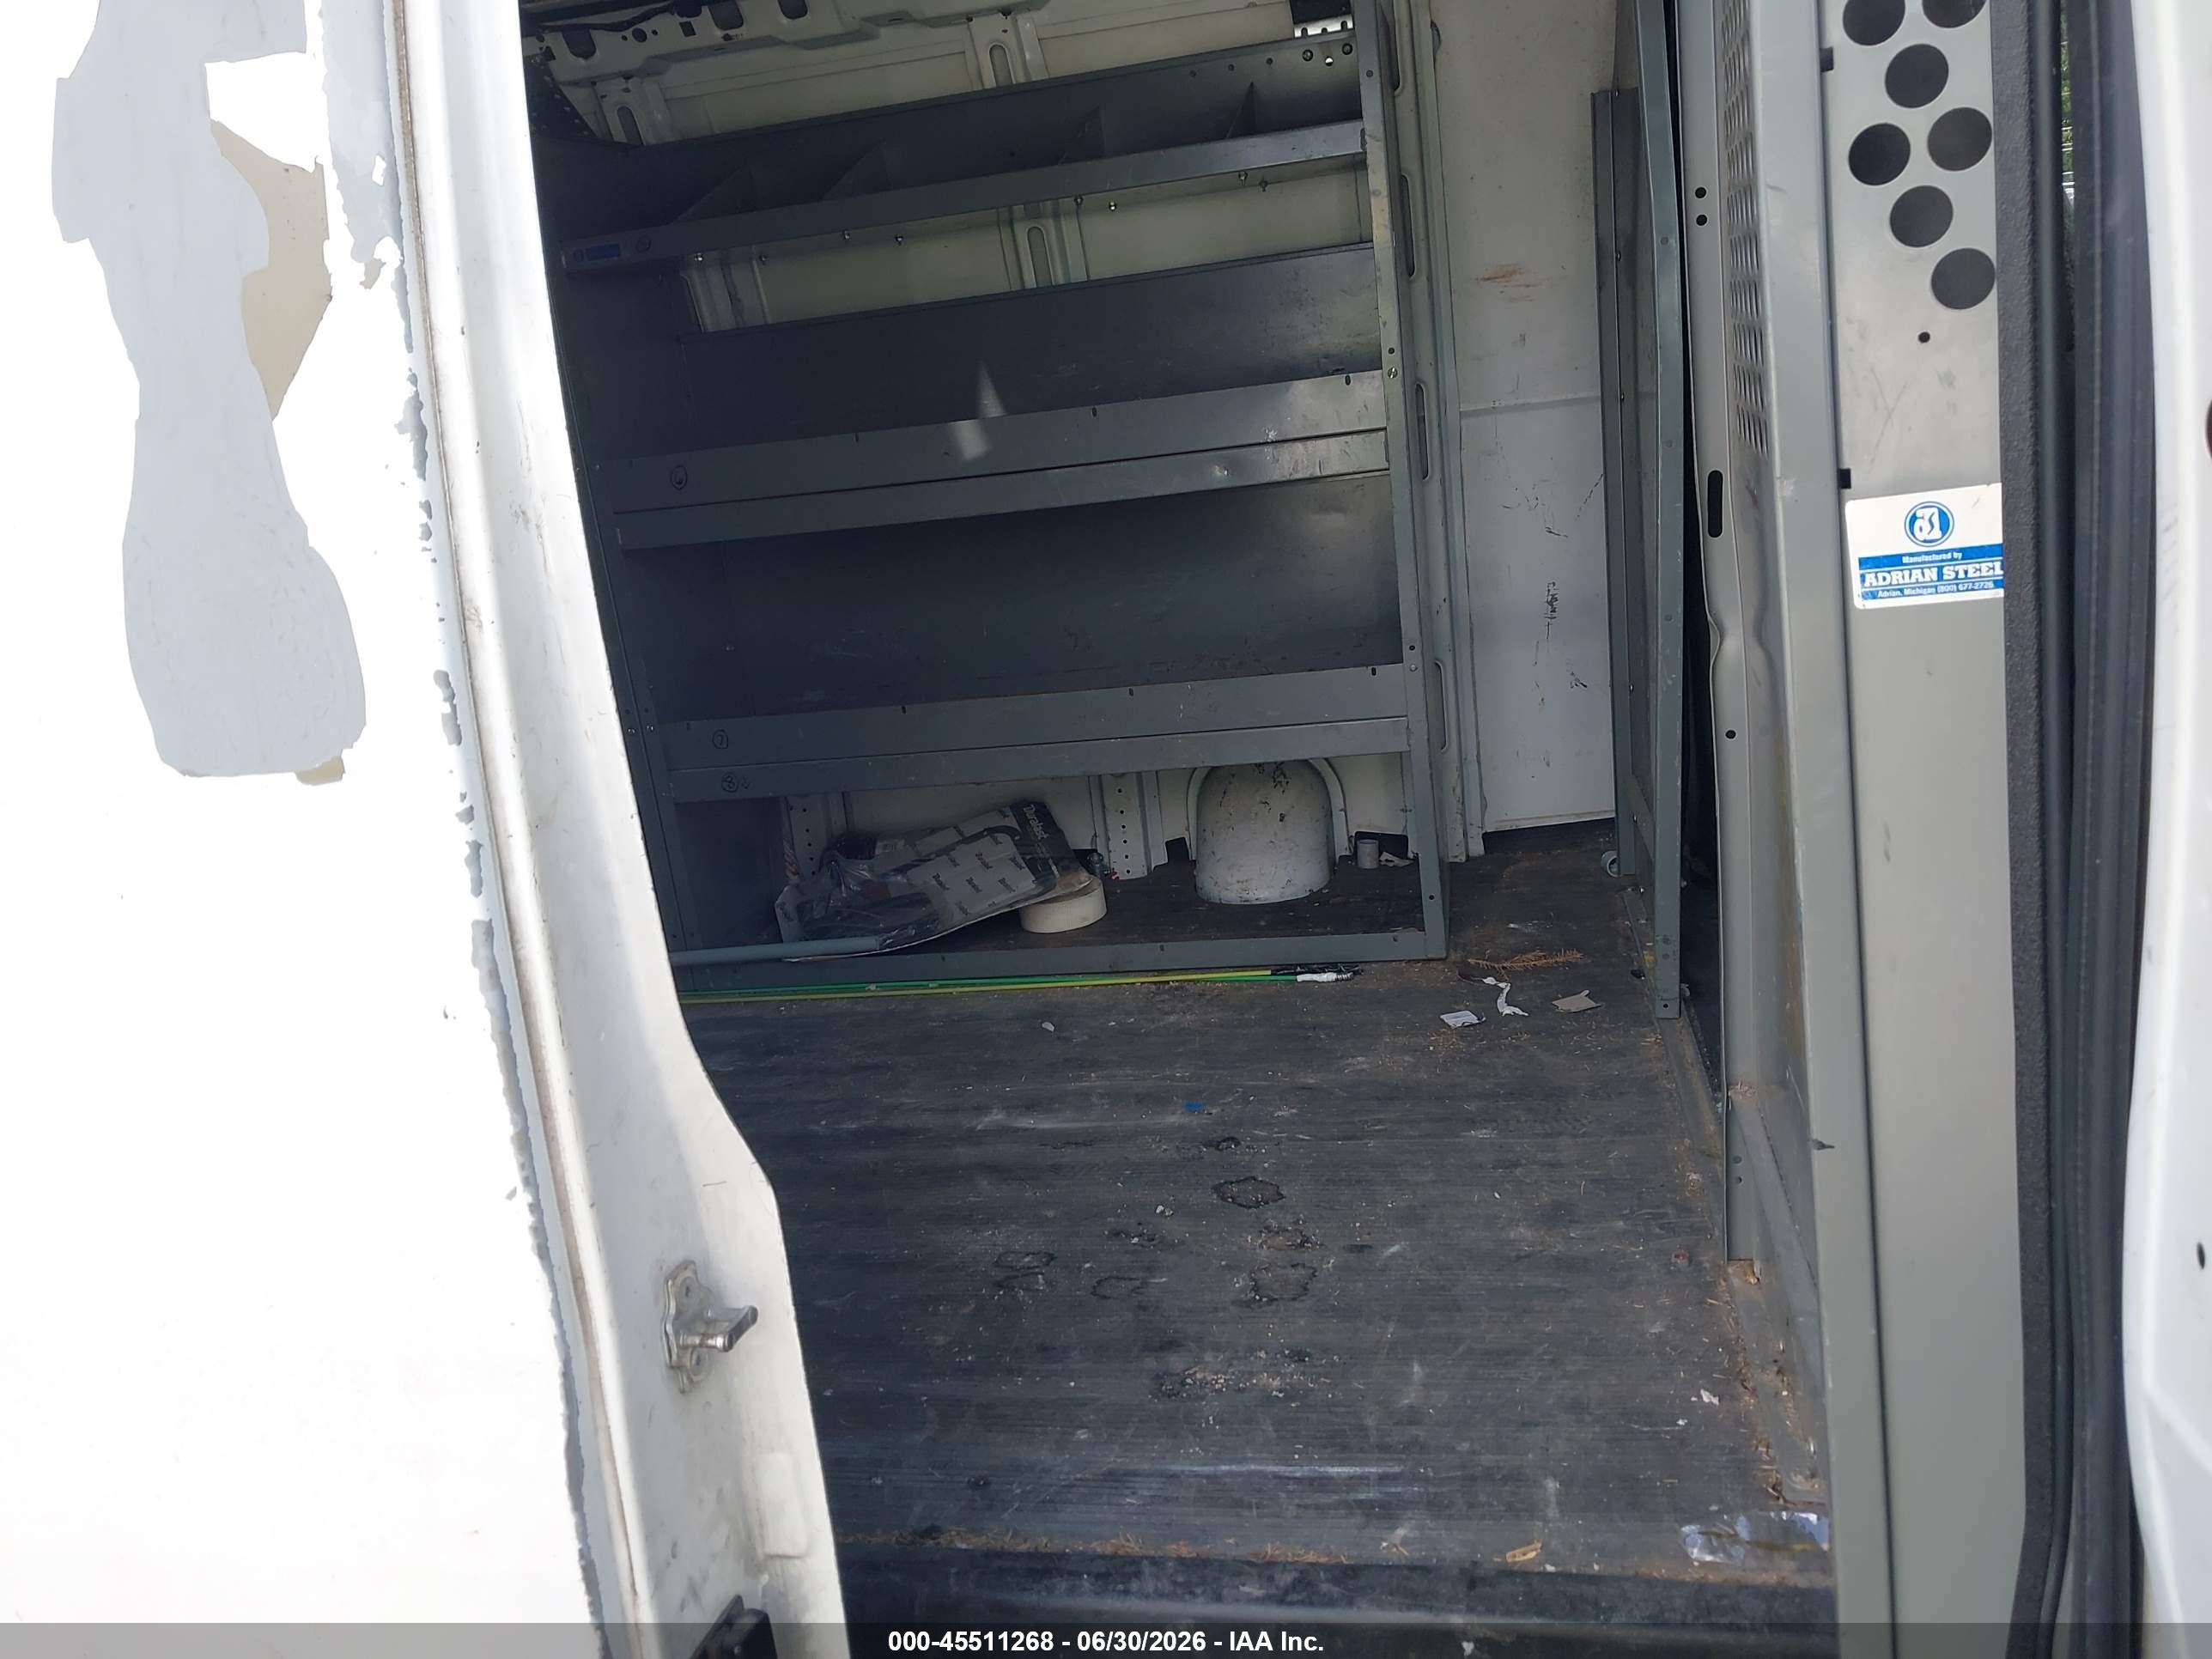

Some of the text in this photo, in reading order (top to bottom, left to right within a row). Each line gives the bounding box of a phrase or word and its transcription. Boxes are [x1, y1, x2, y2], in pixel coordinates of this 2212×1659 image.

[1902, 551, 1962, 563] Manufactured by
[1864, 562, 2003, 586] ADRIAN STEEL
[1904, 587, 1936, 597] Michigan
[1023, 804, 1049, 840] Duralast
